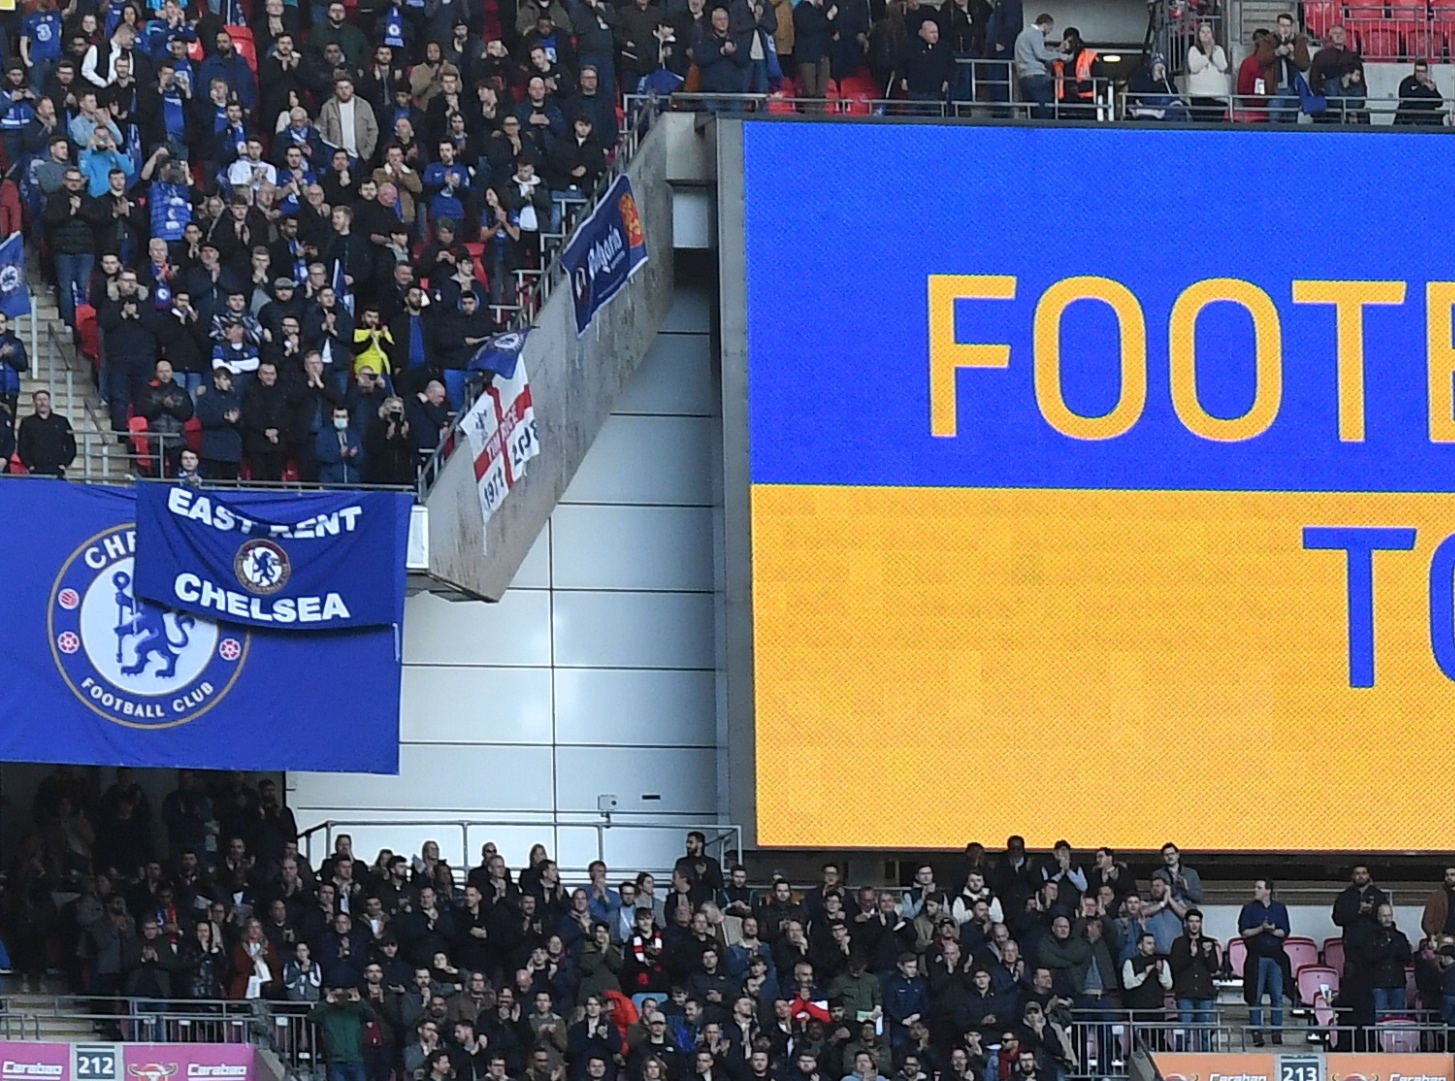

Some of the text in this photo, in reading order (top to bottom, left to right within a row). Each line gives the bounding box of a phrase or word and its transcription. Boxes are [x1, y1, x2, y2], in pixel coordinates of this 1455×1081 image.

[168, 487, 258, 534] EAST
[174, 573, 351, 623] CHELSEA
[81, 676, 214, 718] FOOTBALL CLUB
[2, 1061, 64, 1075] Carabao
[78, 1057, 115, 1074] 212
[187, 1063, 248, 1077] Carabao
